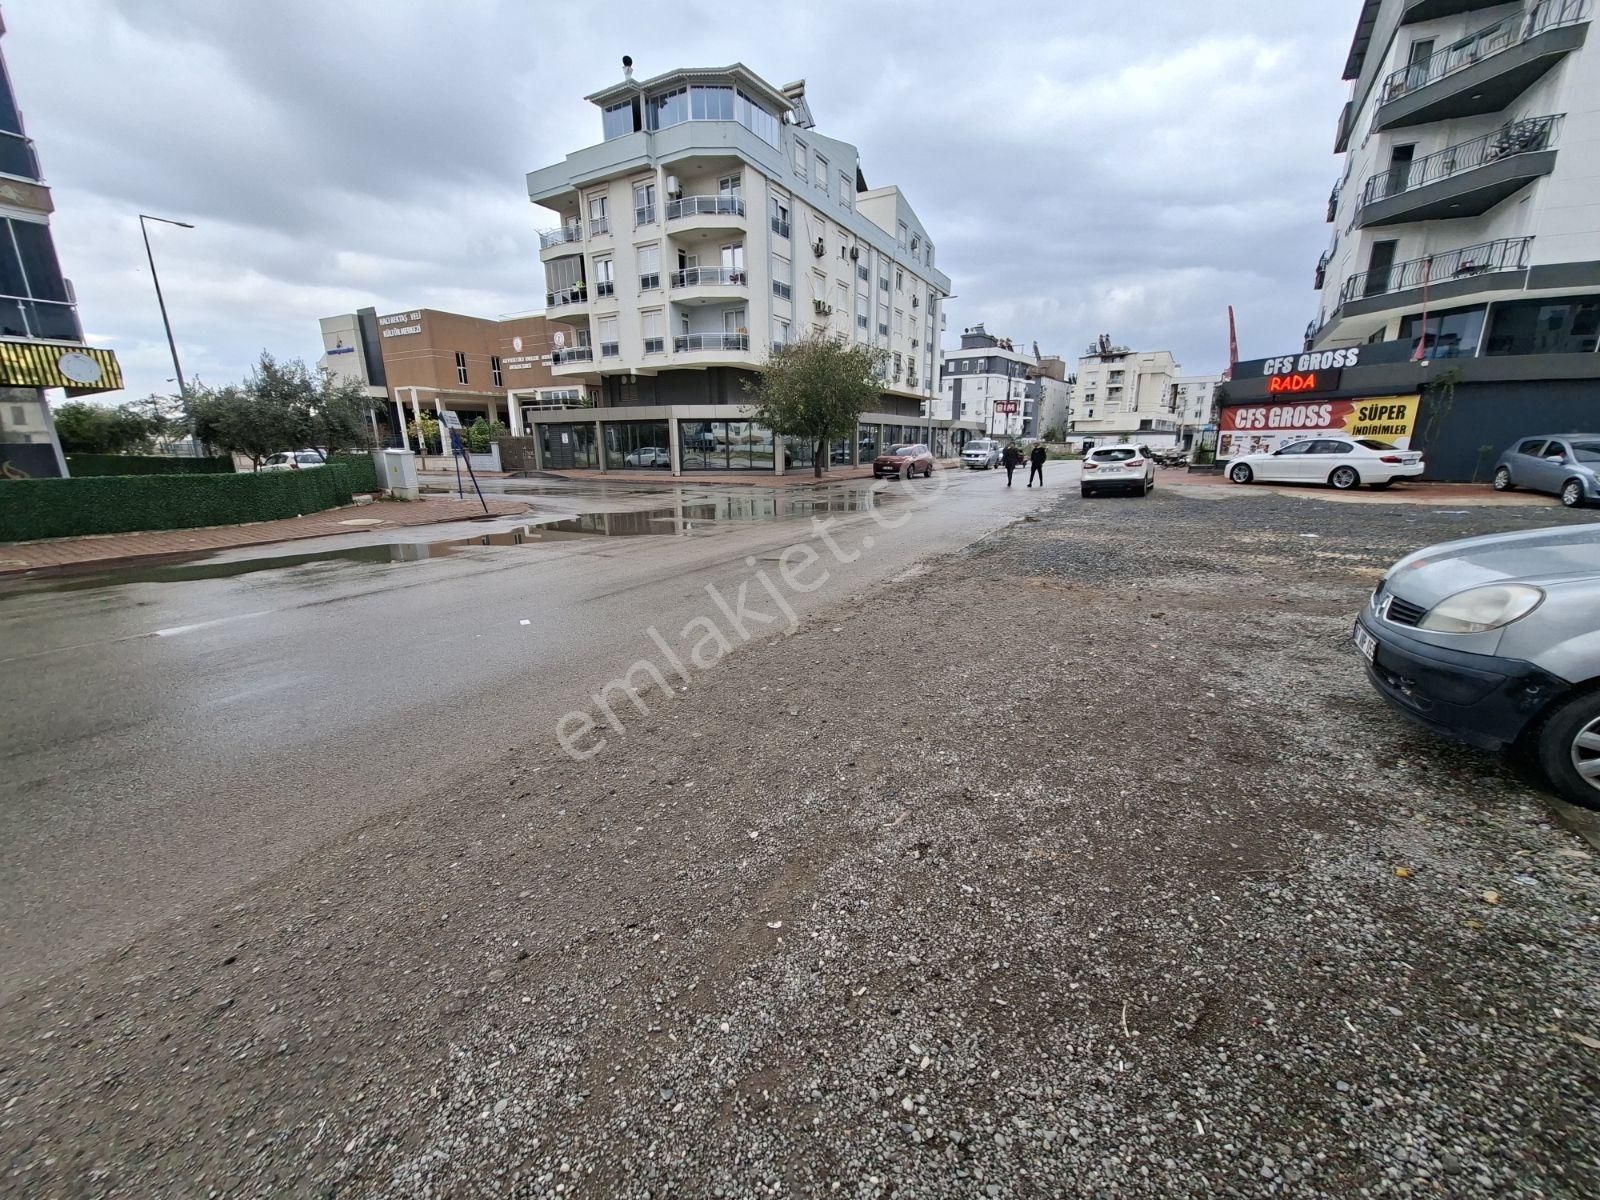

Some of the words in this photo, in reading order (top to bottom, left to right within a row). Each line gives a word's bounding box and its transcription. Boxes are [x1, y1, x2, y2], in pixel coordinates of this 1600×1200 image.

[1263, 357, 1294, 376] CFS
[1298, 348, 1359, 371] GROSS
[1270, 374, 1315, 391] RADA
[1235, 408, 1266, 429] CFS
[1268, 404, 1332, 428] GROSS
[1358, 404, 1407, 422] SÜPER
[1352, 423, 1407, 436] İNDİRİMLER
